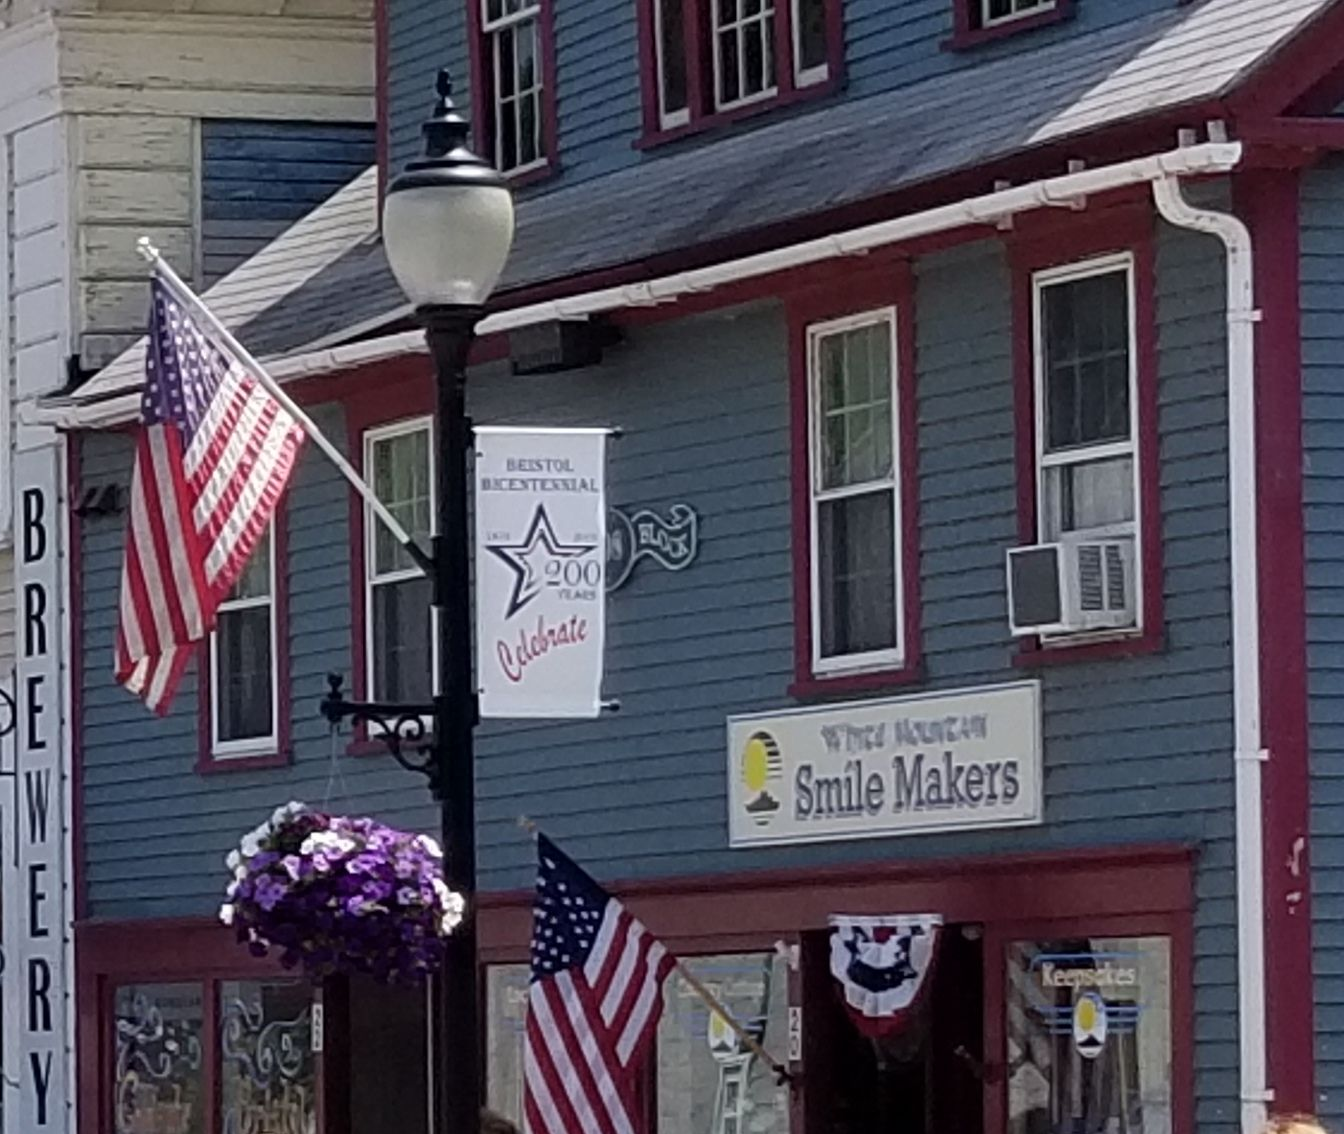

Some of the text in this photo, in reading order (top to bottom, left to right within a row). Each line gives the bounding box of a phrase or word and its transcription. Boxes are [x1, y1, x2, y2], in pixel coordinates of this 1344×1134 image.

[638, 523, 690, 558] BLOCK
[544, 559, 601, 586] 200
[496, 614, 588, 682] Celebrate
[22, 488, 52, 1126] BREWERY
[794, 750, 1021, 821] Smile Makers
[1041, 961, 1137, 992] Keepsakes
